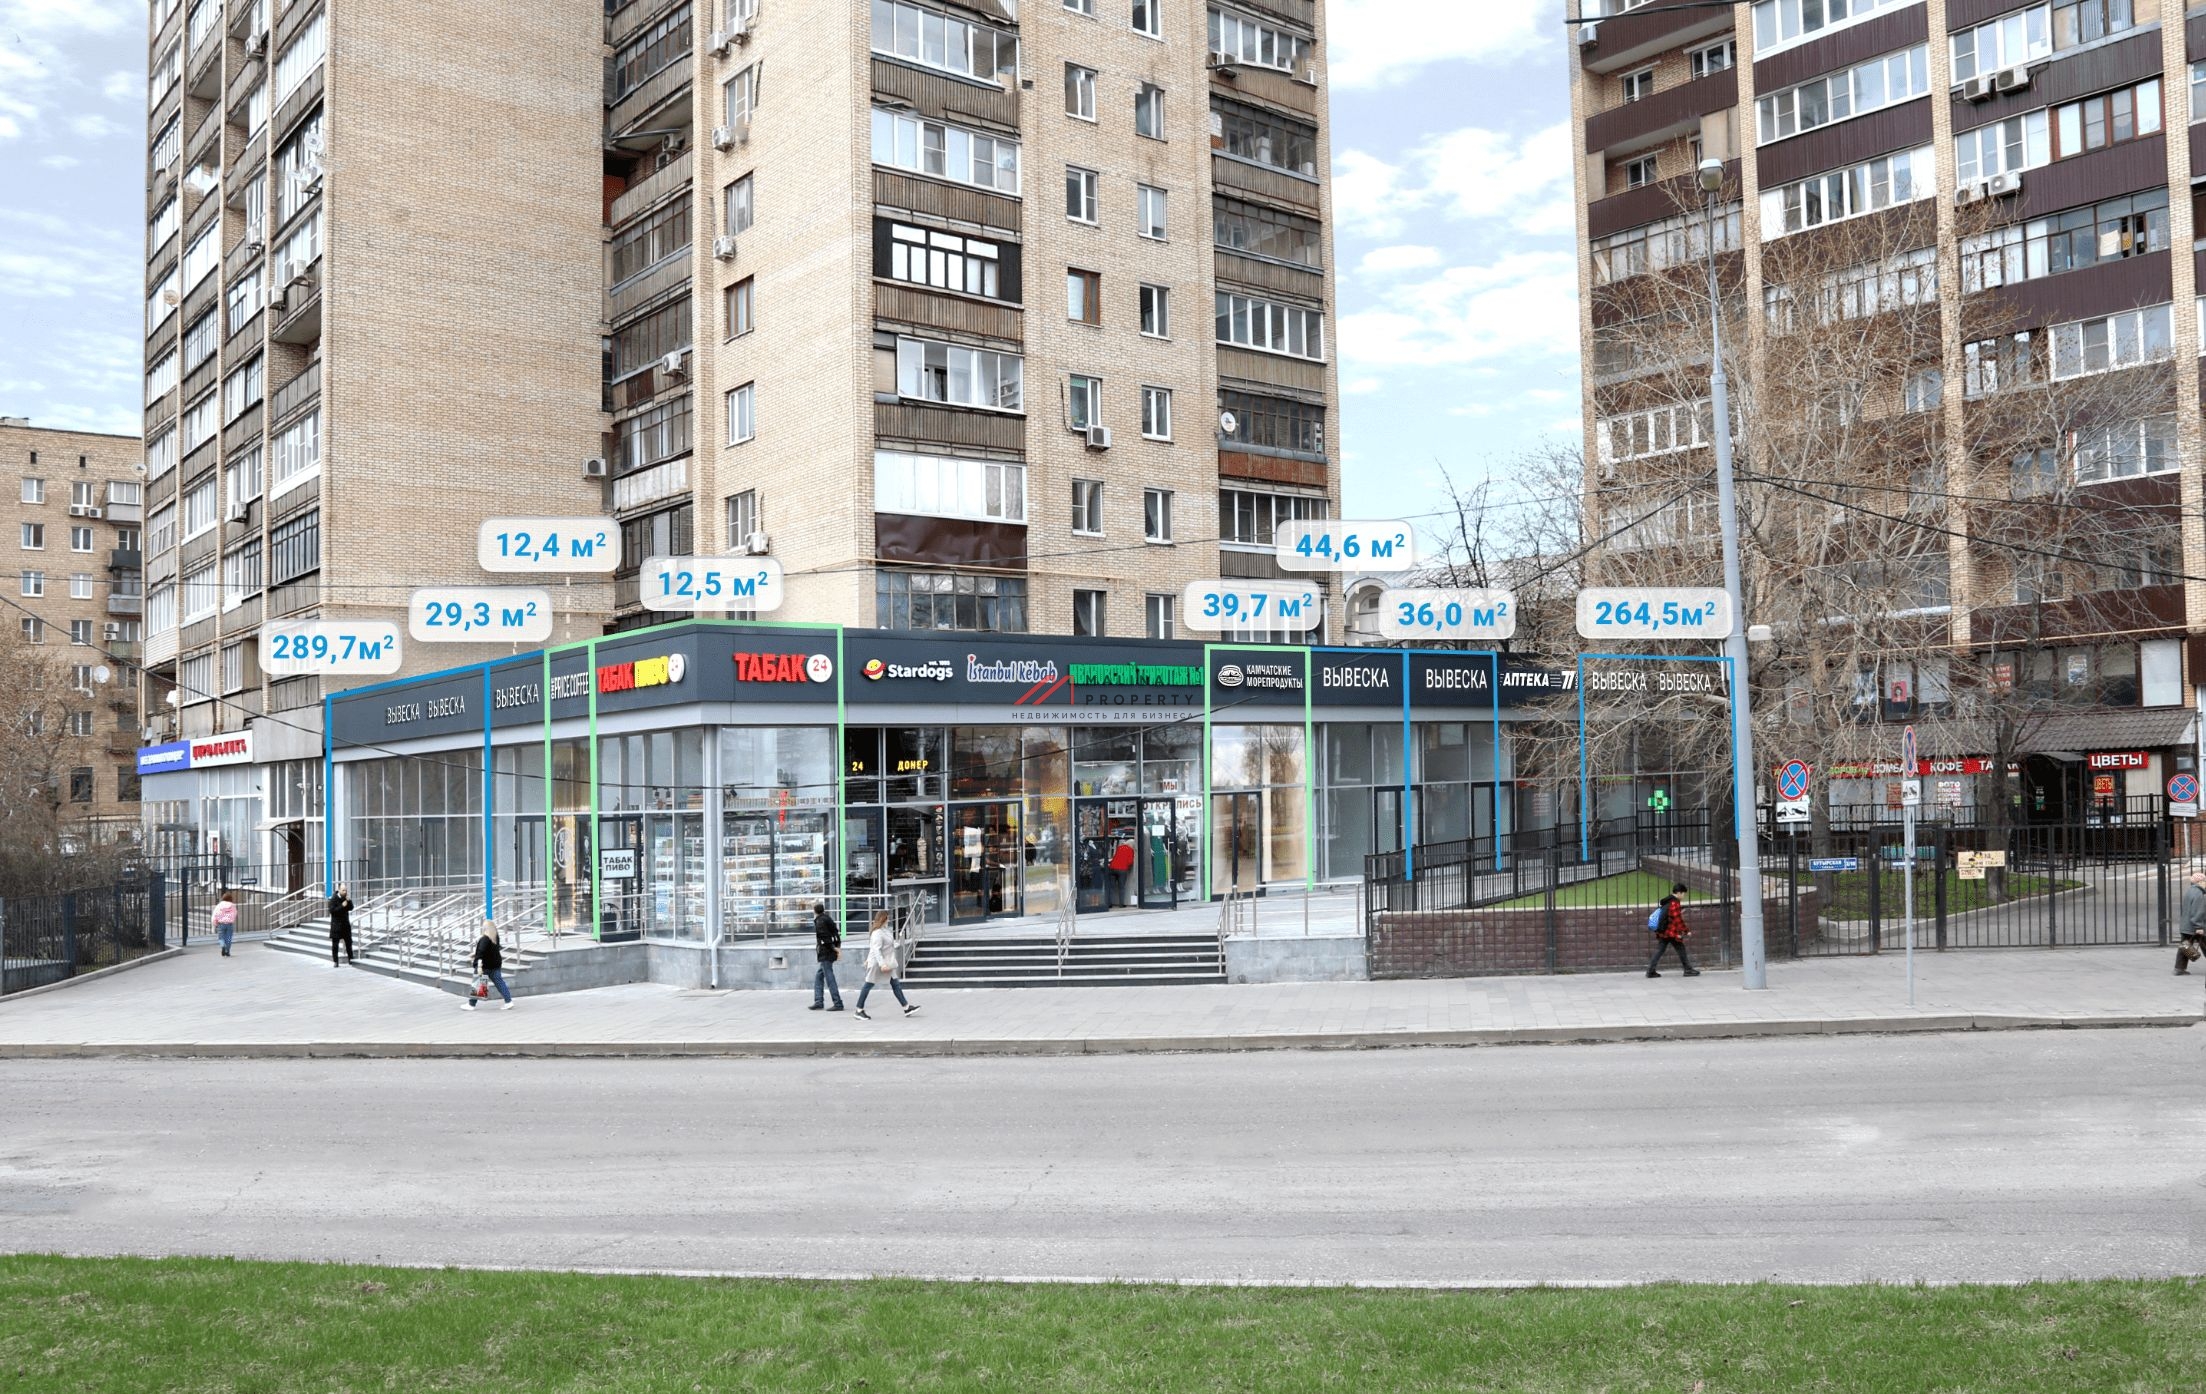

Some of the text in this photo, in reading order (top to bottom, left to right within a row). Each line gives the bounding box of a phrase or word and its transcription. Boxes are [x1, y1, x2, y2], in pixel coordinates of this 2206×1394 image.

[733, 653, 828, 682] ТАБАК 24
[887, 664, 954, 681] Stardogs
[1069, 661, 1137, 685] ИВАНОВСКИЙ
[1137, 665, 1189, 686] ТРИКОТАЖ
[1246, 664, 1292, 676] КАМЧАТСКИЕ
[554, 671, 589, 699] PRICE COFFEE
[597, 662, 635, 693] ТАБАК
[1246, 676, 1304, 690] МОРЕПРОДУКТЫ
[1323, 667, 1389, 688] ВЫВЕСКА
[1426, 668, 1488, 689] ВЫВЕСКА
[1503, 672, 1550, 687] АПТЕКА
[1592, 671, 1648, 691] ВЫВЕСКА
[1659, 672, 1712, 692] ВЫВЕСКА
[495, 683, 539, 709] ВЫВЕСКА
[387, 696, 465, 724] ВЫВЕСКА ВЫВЕСКА
[851, 759, 930, 772] 24 ДОНЕР
[1872, 762, 1919, 774] ЛОМБА
[1930, 761, 1963, 772] КОФЕ
[2090, 753, 2143, 768] ЦВЕТЫ
[1163, 781, 1178, 790] МЫ
[605, 863, 631, 871] ПИВО
